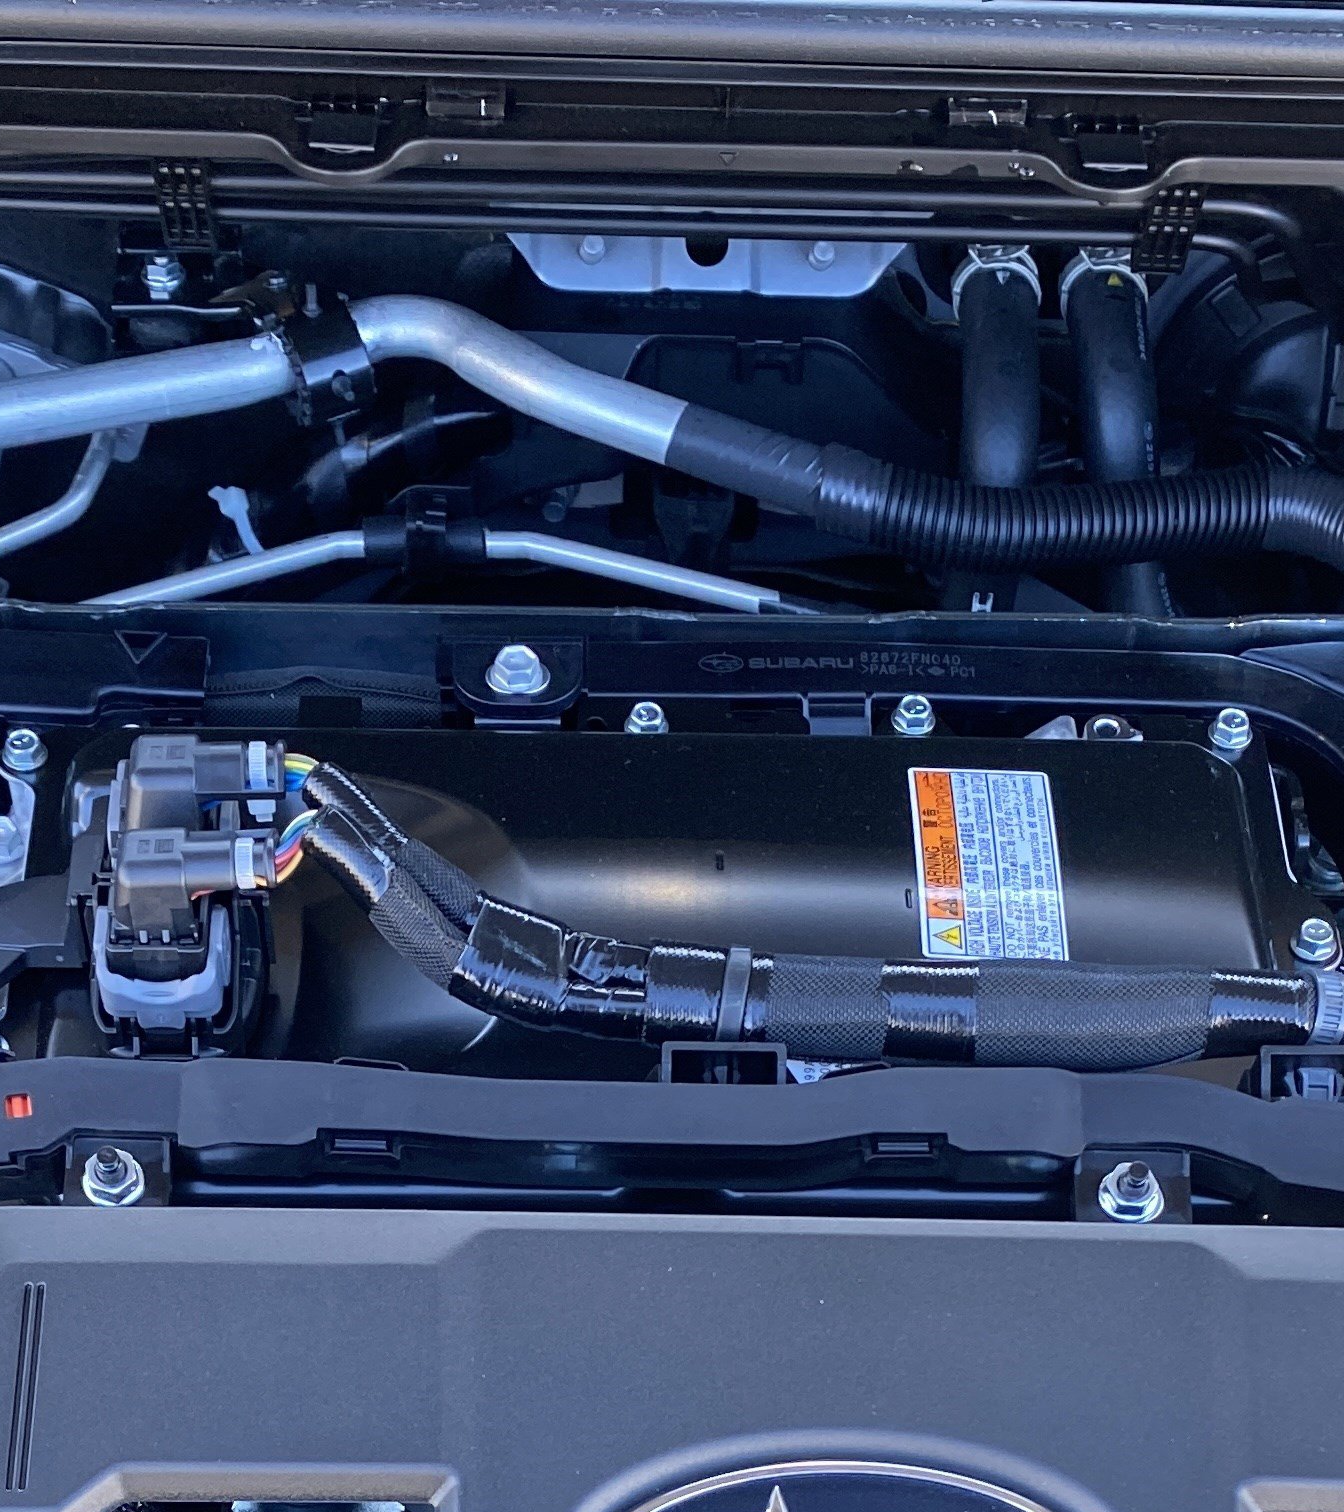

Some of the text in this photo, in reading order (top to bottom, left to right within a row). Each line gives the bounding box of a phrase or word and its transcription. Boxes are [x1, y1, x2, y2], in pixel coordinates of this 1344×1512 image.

[749, 656, 854, 670] SUBARU
[1004, 921, 1015, 939] NOT
[1036, 925, 1049, 942] PAS
[1006, 943, 1017, 956] DO
